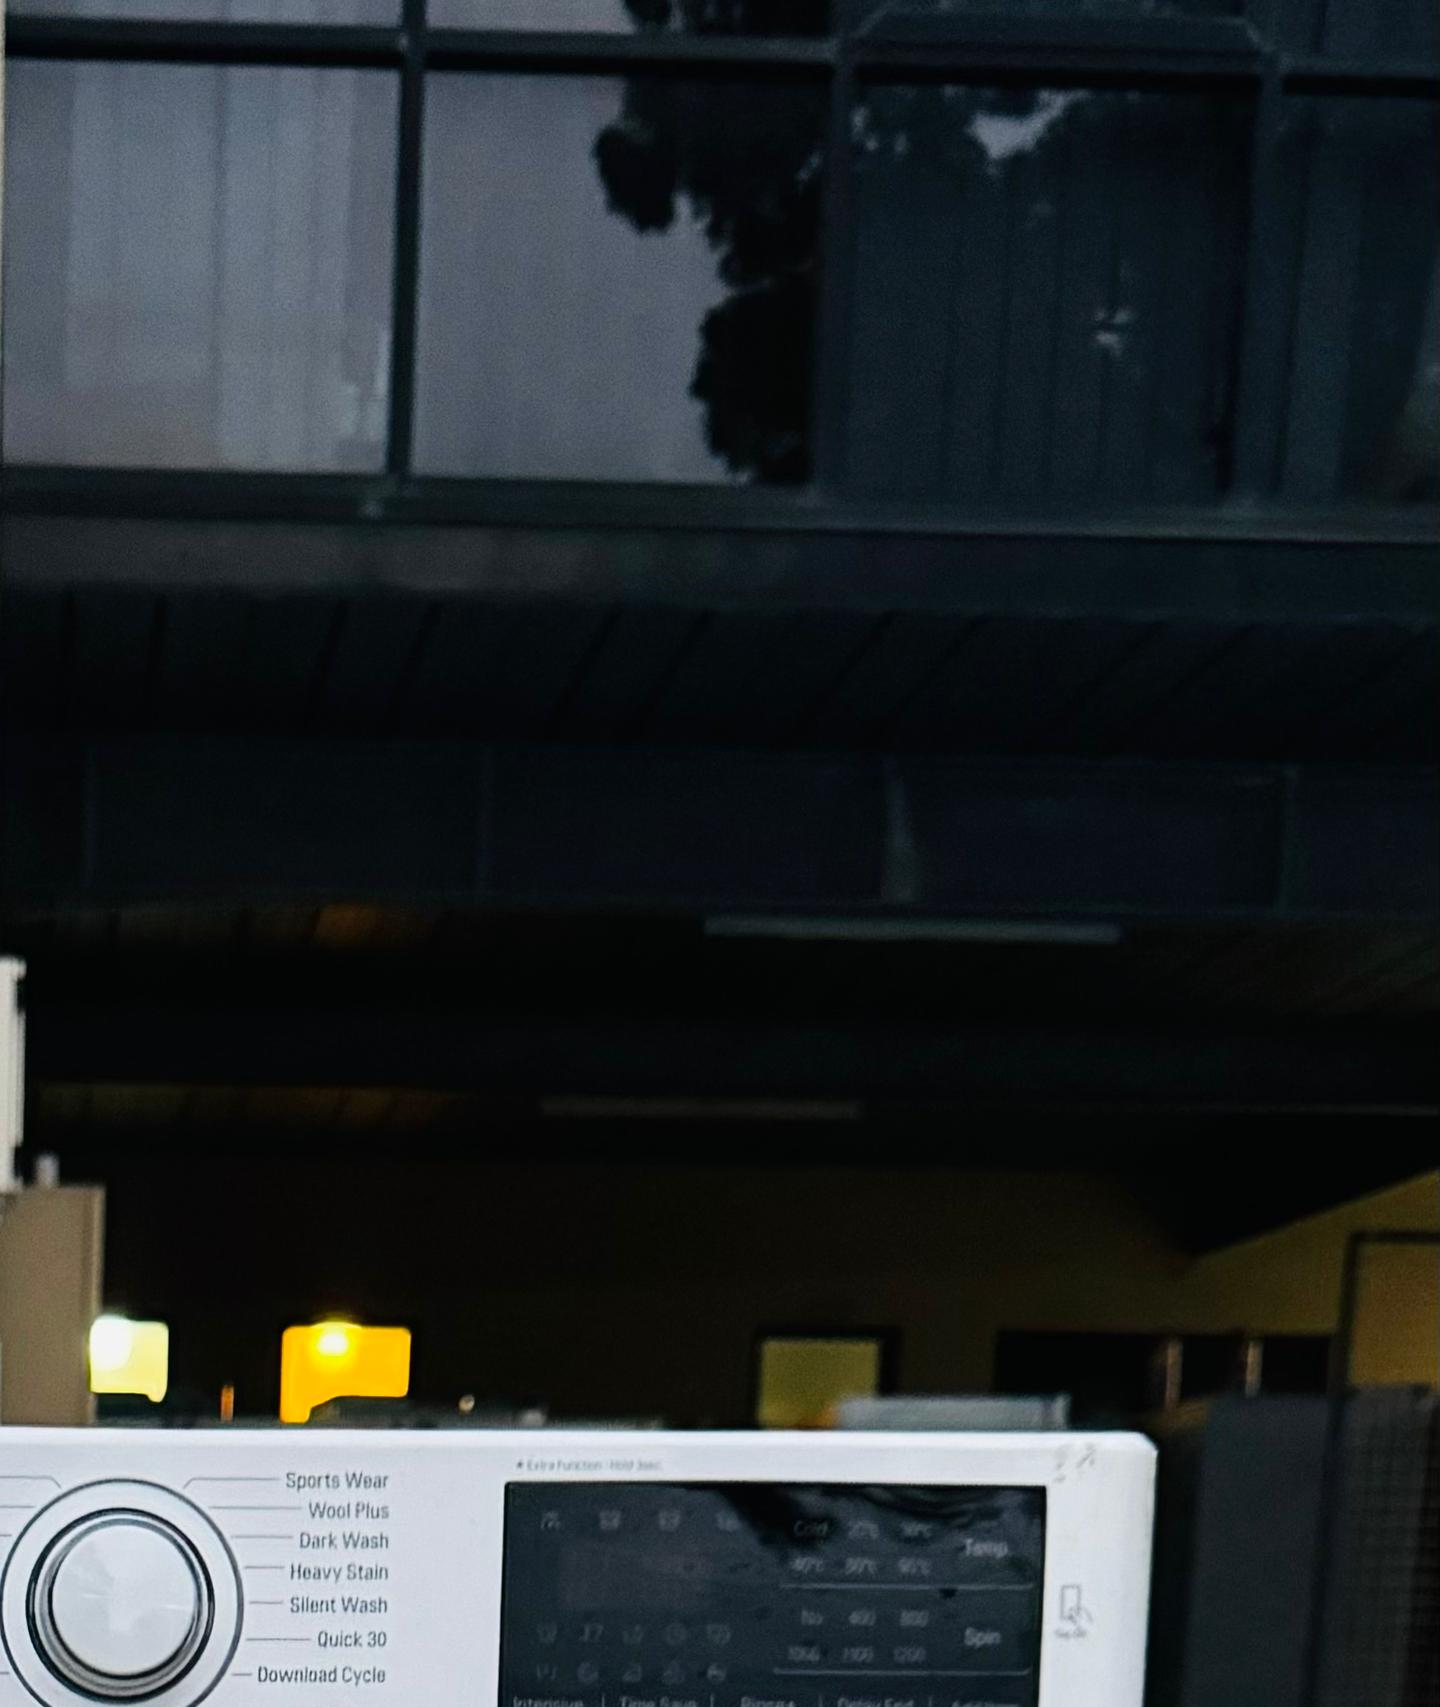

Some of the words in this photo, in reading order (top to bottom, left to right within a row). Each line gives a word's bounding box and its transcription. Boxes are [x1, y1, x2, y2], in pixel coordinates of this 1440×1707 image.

[286, 1472, 340, 1492] Sports
[345, 1472, 389, 1489] Wear
[309, 1503, 351, 1519] Wool
[355, 1503, 389, 1519] Plus
[299, 1532, 337, 1549] Dark
[343, 1532, 389, 1549] Wash
[290, 1563, 342, 1583] Heavy
[347, 1564, 389, 1580] Stain
[290, 1597, 336, 1613] Silent
[341, 1597, 388, 1613] Wash
[317, 1631, 362, 1648] Quick
[367, 1631, 387, 1647] 30
[257, 1666, 337, 1683] Download
[342, 1667, 386, 1687] Cycle
